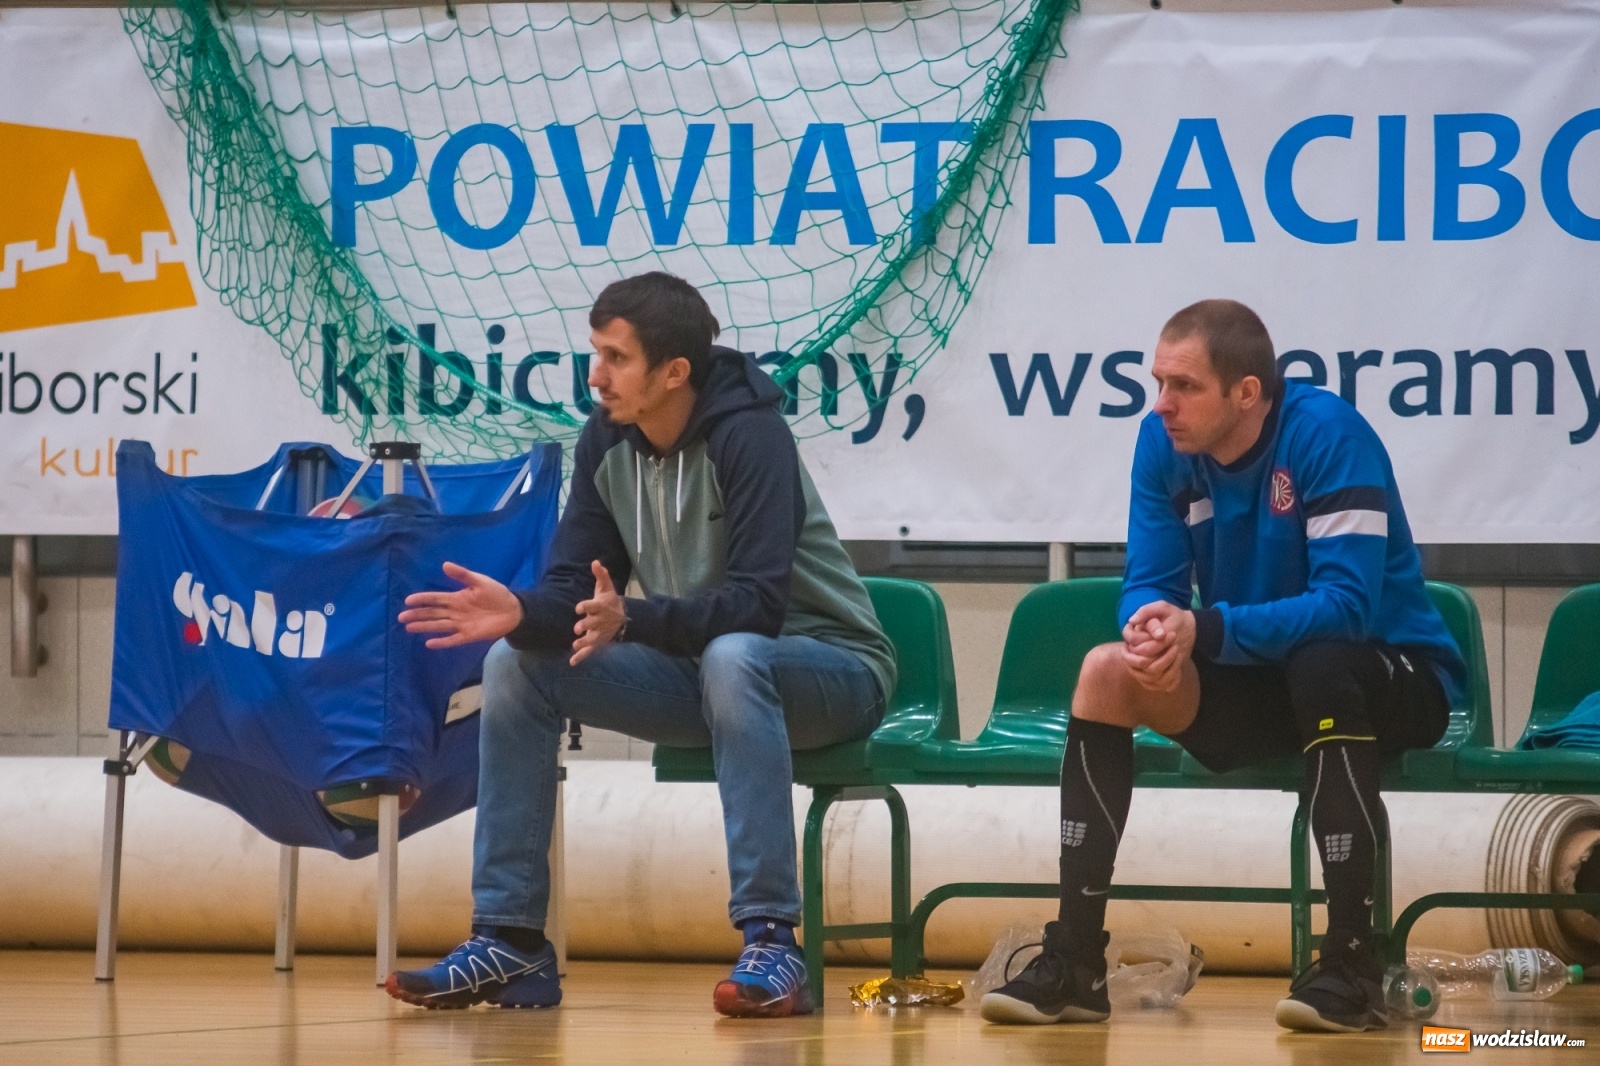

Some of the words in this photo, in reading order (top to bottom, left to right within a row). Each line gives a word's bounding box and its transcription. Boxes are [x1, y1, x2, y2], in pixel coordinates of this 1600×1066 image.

[331, 122, 974, 249] POWIAT
[322, 322, 926, 442] kibicmy,
[989, 347, 1600, 444] wseramy
